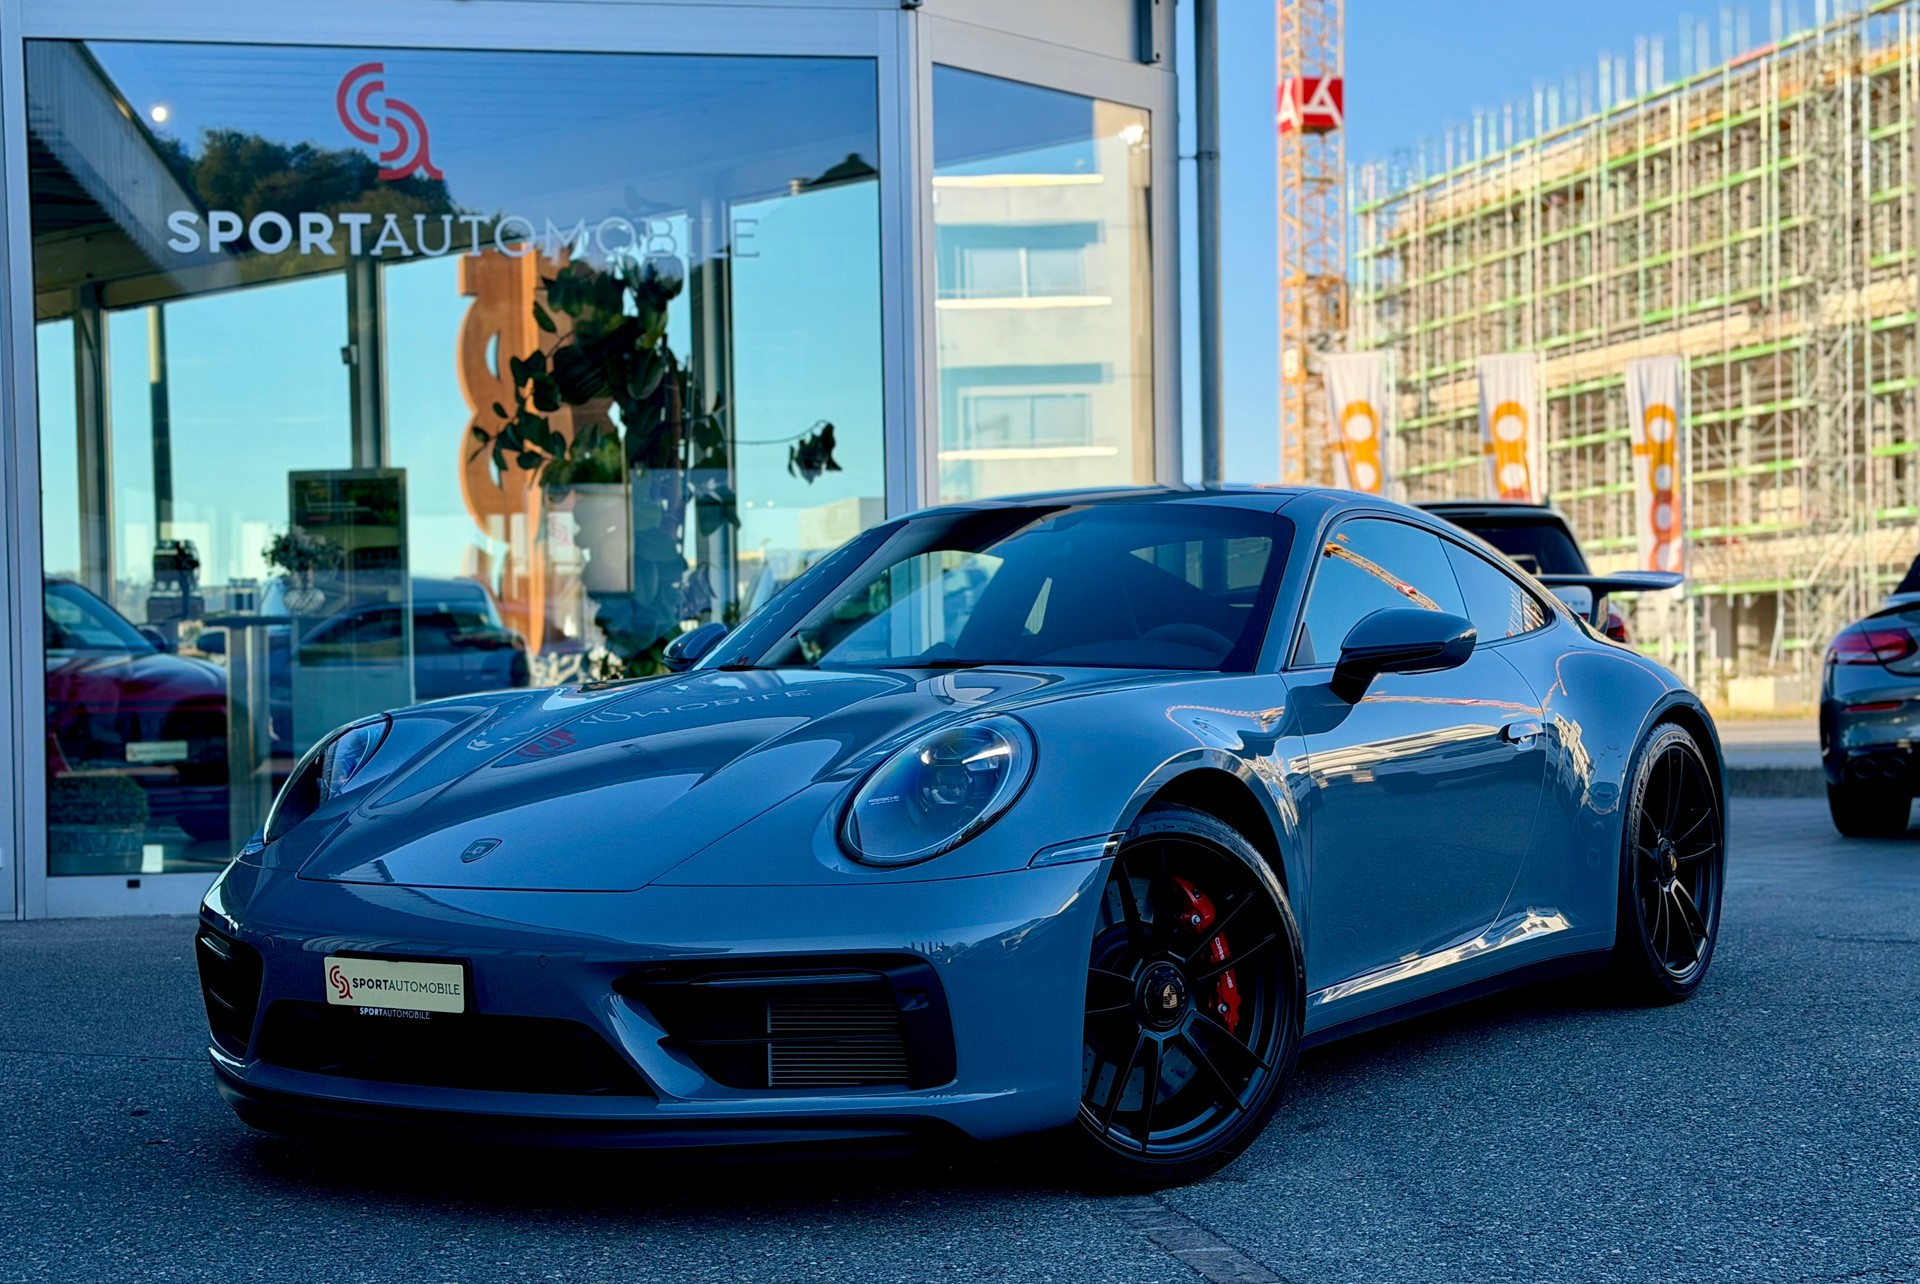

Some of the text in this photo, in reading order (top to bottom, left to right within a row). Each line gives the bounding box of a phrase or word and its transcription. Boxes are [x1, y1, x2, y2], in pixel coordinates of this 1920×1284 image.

[167, 210, 760, 258] SPORTAUTOMOBILE
[352, 977, 460, 995] SPORTAUTOMOBILE
[359, 1007, 430, 1019] SPORTAUTOMOBILE
